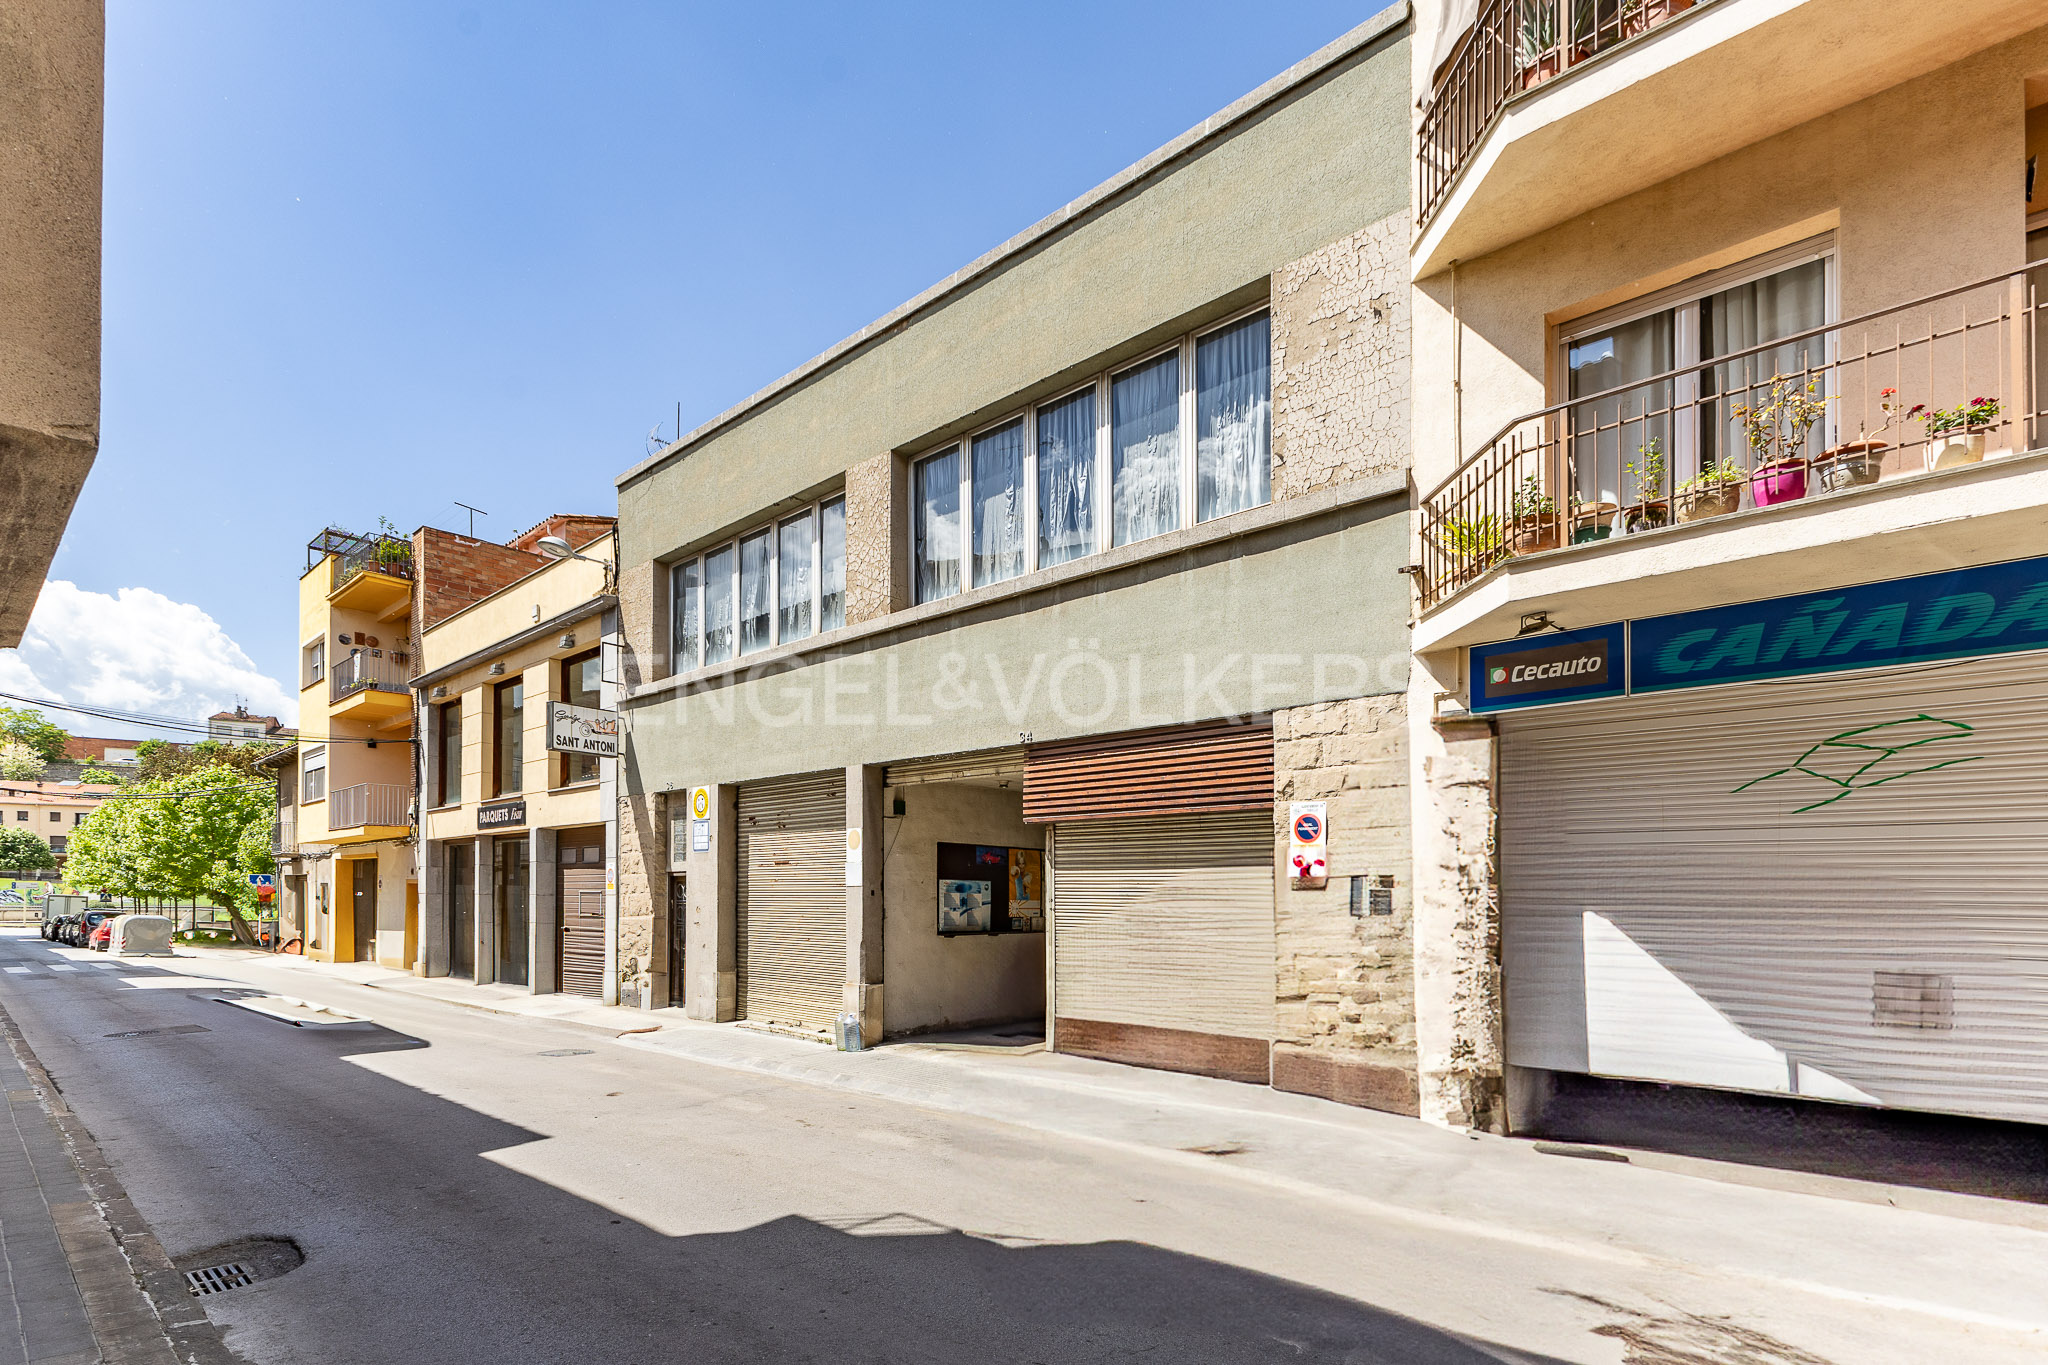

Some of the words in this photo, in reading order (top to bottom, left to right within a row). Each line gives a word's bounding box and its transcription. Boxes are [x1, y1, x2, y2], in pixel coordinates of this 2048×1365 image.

[1652, 582, 2048, 674] CAÑADA
[1511, 656, 1602, 683] Cecauto
[555, 734, 580, 748] SANT
[583, 738, 616, 753] ANTONI
[479, 808, 509, 824] PARQUETS
